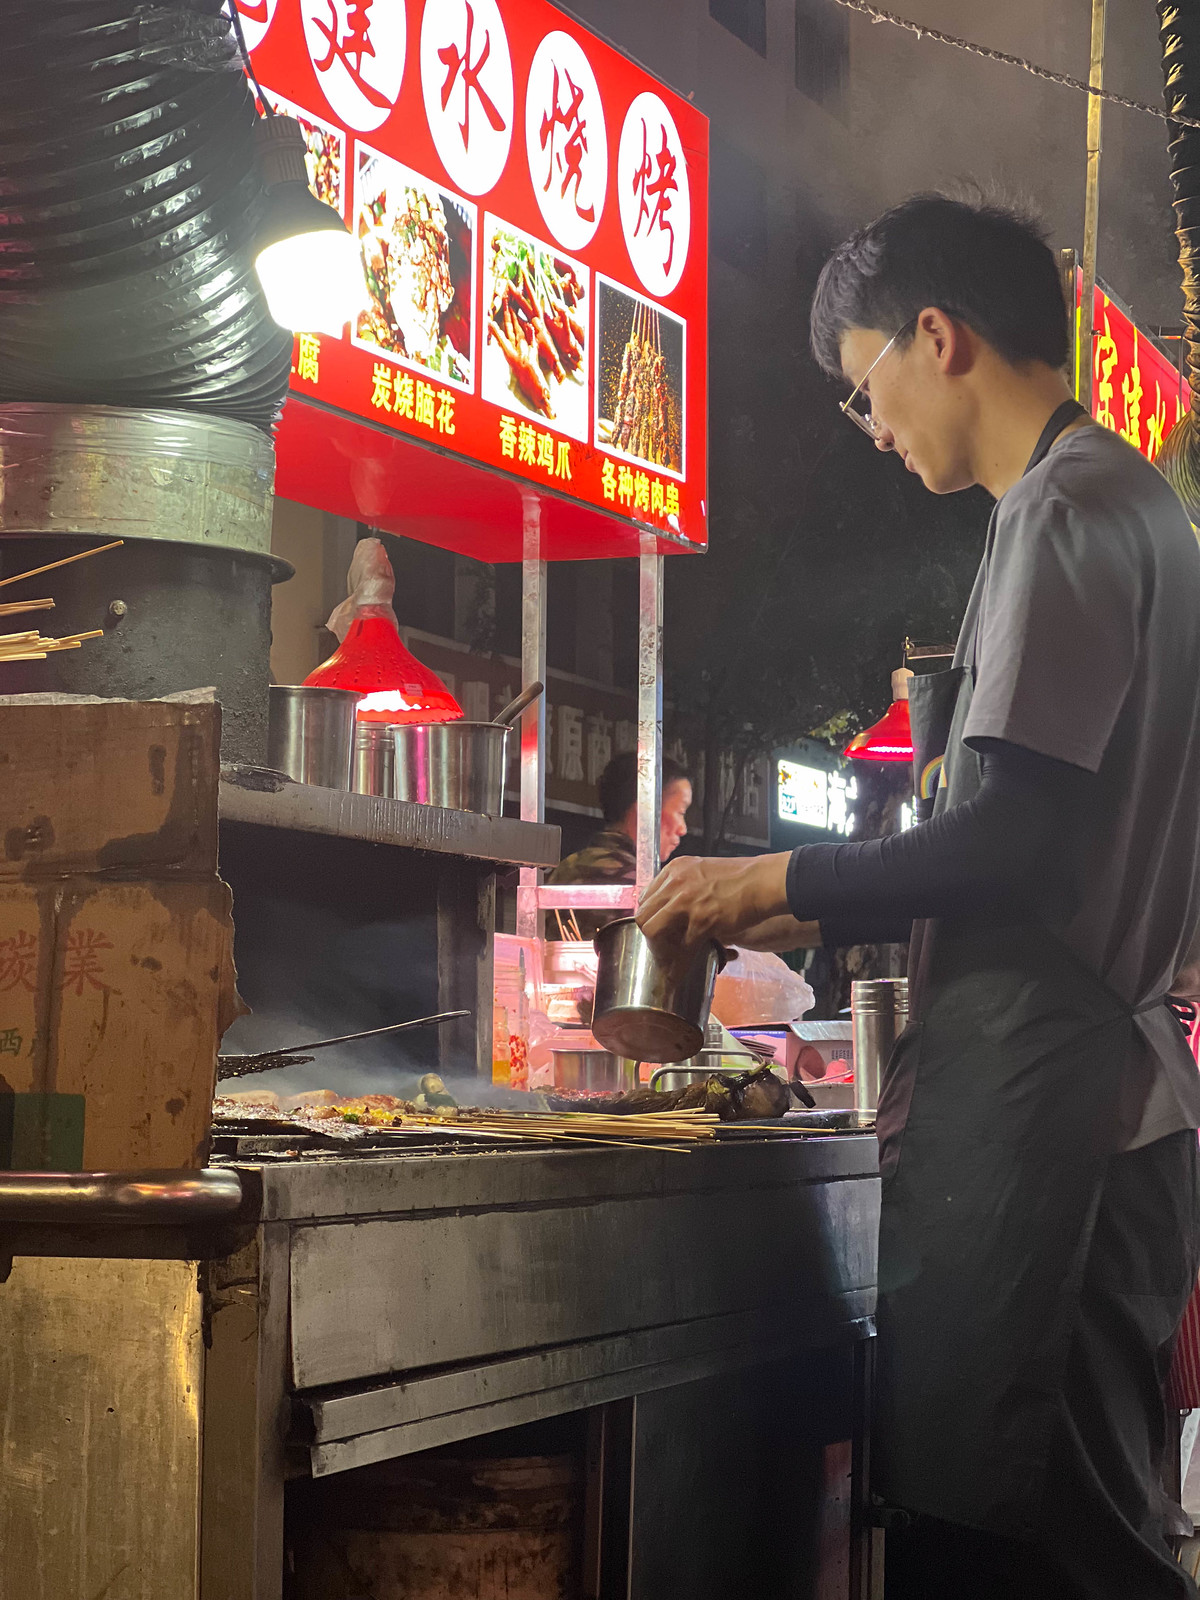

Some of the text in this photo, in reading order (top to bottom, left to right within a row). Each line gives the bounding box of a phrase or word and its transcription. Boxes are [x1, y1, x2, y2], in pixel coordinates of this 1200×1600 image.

[234, 0, 678, 277] 建水烧烤
[291, 333, 320, 384] 腐
[371, 362, 456, 435] 炭烧脑花
[499, 414, 572, 480] 香辣鸡爪
[601, 457, 680, 518] 各种烤肉串
